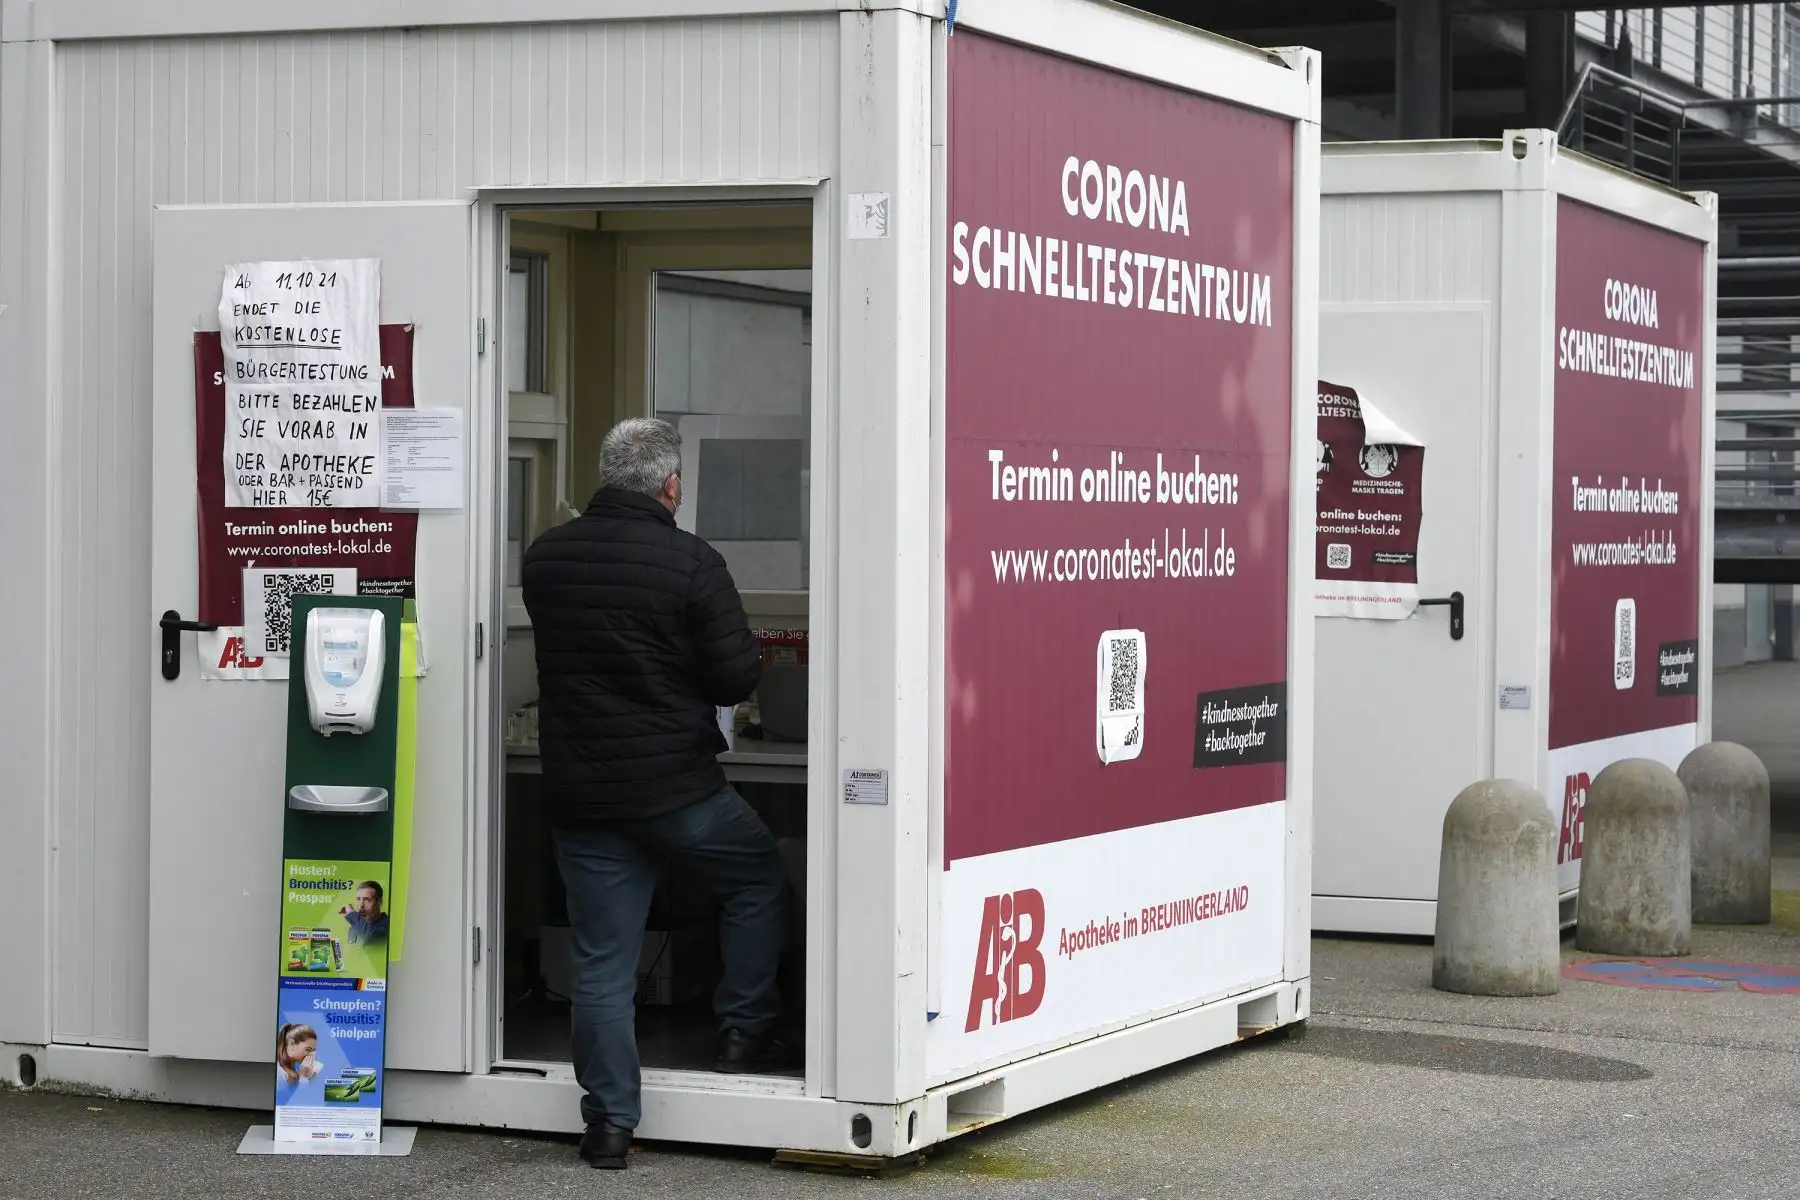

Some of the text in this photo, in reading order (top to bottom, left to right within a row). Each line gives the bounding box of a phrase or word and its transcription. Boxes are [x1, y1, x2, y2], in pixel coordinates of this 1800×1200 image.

[1061, 156, 1190, 237] CORONA
[235, 273, 251, 289] Ab
[952, 221, 1272, 327] SCHNELLTESTZENTRUM
[234, 301, 321, 316] ENDET DIE
[1604, 278, 1659, 328] CORONA
[235, 326, 342, 344] KOSTENLOSE
[1559, 327, 1694, 389] SCHNELLTESTZENTRUM
[236, 359, 368, 380] BÜRGERTESTUNG
[239, 393, 377, 413] BITTE BEZAHLEN
[239, 418, 266, 438] SIE
[278, 420, 335, 440] VORAB
[349, 422, 368, 440] IN
[236, 453, 265, 471] DER
[280, 453, 375, 475] APOTHEKE
[239, 475, 263, 487] ODER
[270, 472, 296, 488] BAR
[309, 474, 363, 489] PASSEND
[988, 449, 1239, 505] Termin online buchen:
[253, 489, 333, 507] HIER 15€
[1572, 475, 1678, 514] Termin online buchen:
[1320, 508, 1402, 521] online buchen:
[225, 518, 393, 536] Termin online buchen:
[1315, 523, 1401, 536] oronatest-lokal.de
[227, 538, 392, 557] www.coronatest-lokal.de
[990, 528, 1236, 584] www.coronatest-lokal.de
[1572, 529, 1676, 566] www.coronatest-lokal.de
[360, 579, 413, 588] #kindnesstogether
[361, 586, 404, 595] #backtogether
[787, 628, 803, 640] Sie
[1202, 695, 1278, 725] #kindnesstogether
[1205, 726, 1266, 754] #backtogether
[290, 864, 337, 876] Husten?
[289, 878, 353, 890] Bronchitis?
[288, 892, 332, 905] Prospan
[1059, 916, 1120, 960] Apotheke
[1123, 912, 1138, 940] im
[1141, 885, 1249, 935] BREUNINGERLAND
[313, 997, 381, 1013] Schnupfen?
[326, 1013, 380, 1025] Sinusitis?
[331, 1027, 377, 1040] Sinolpan
